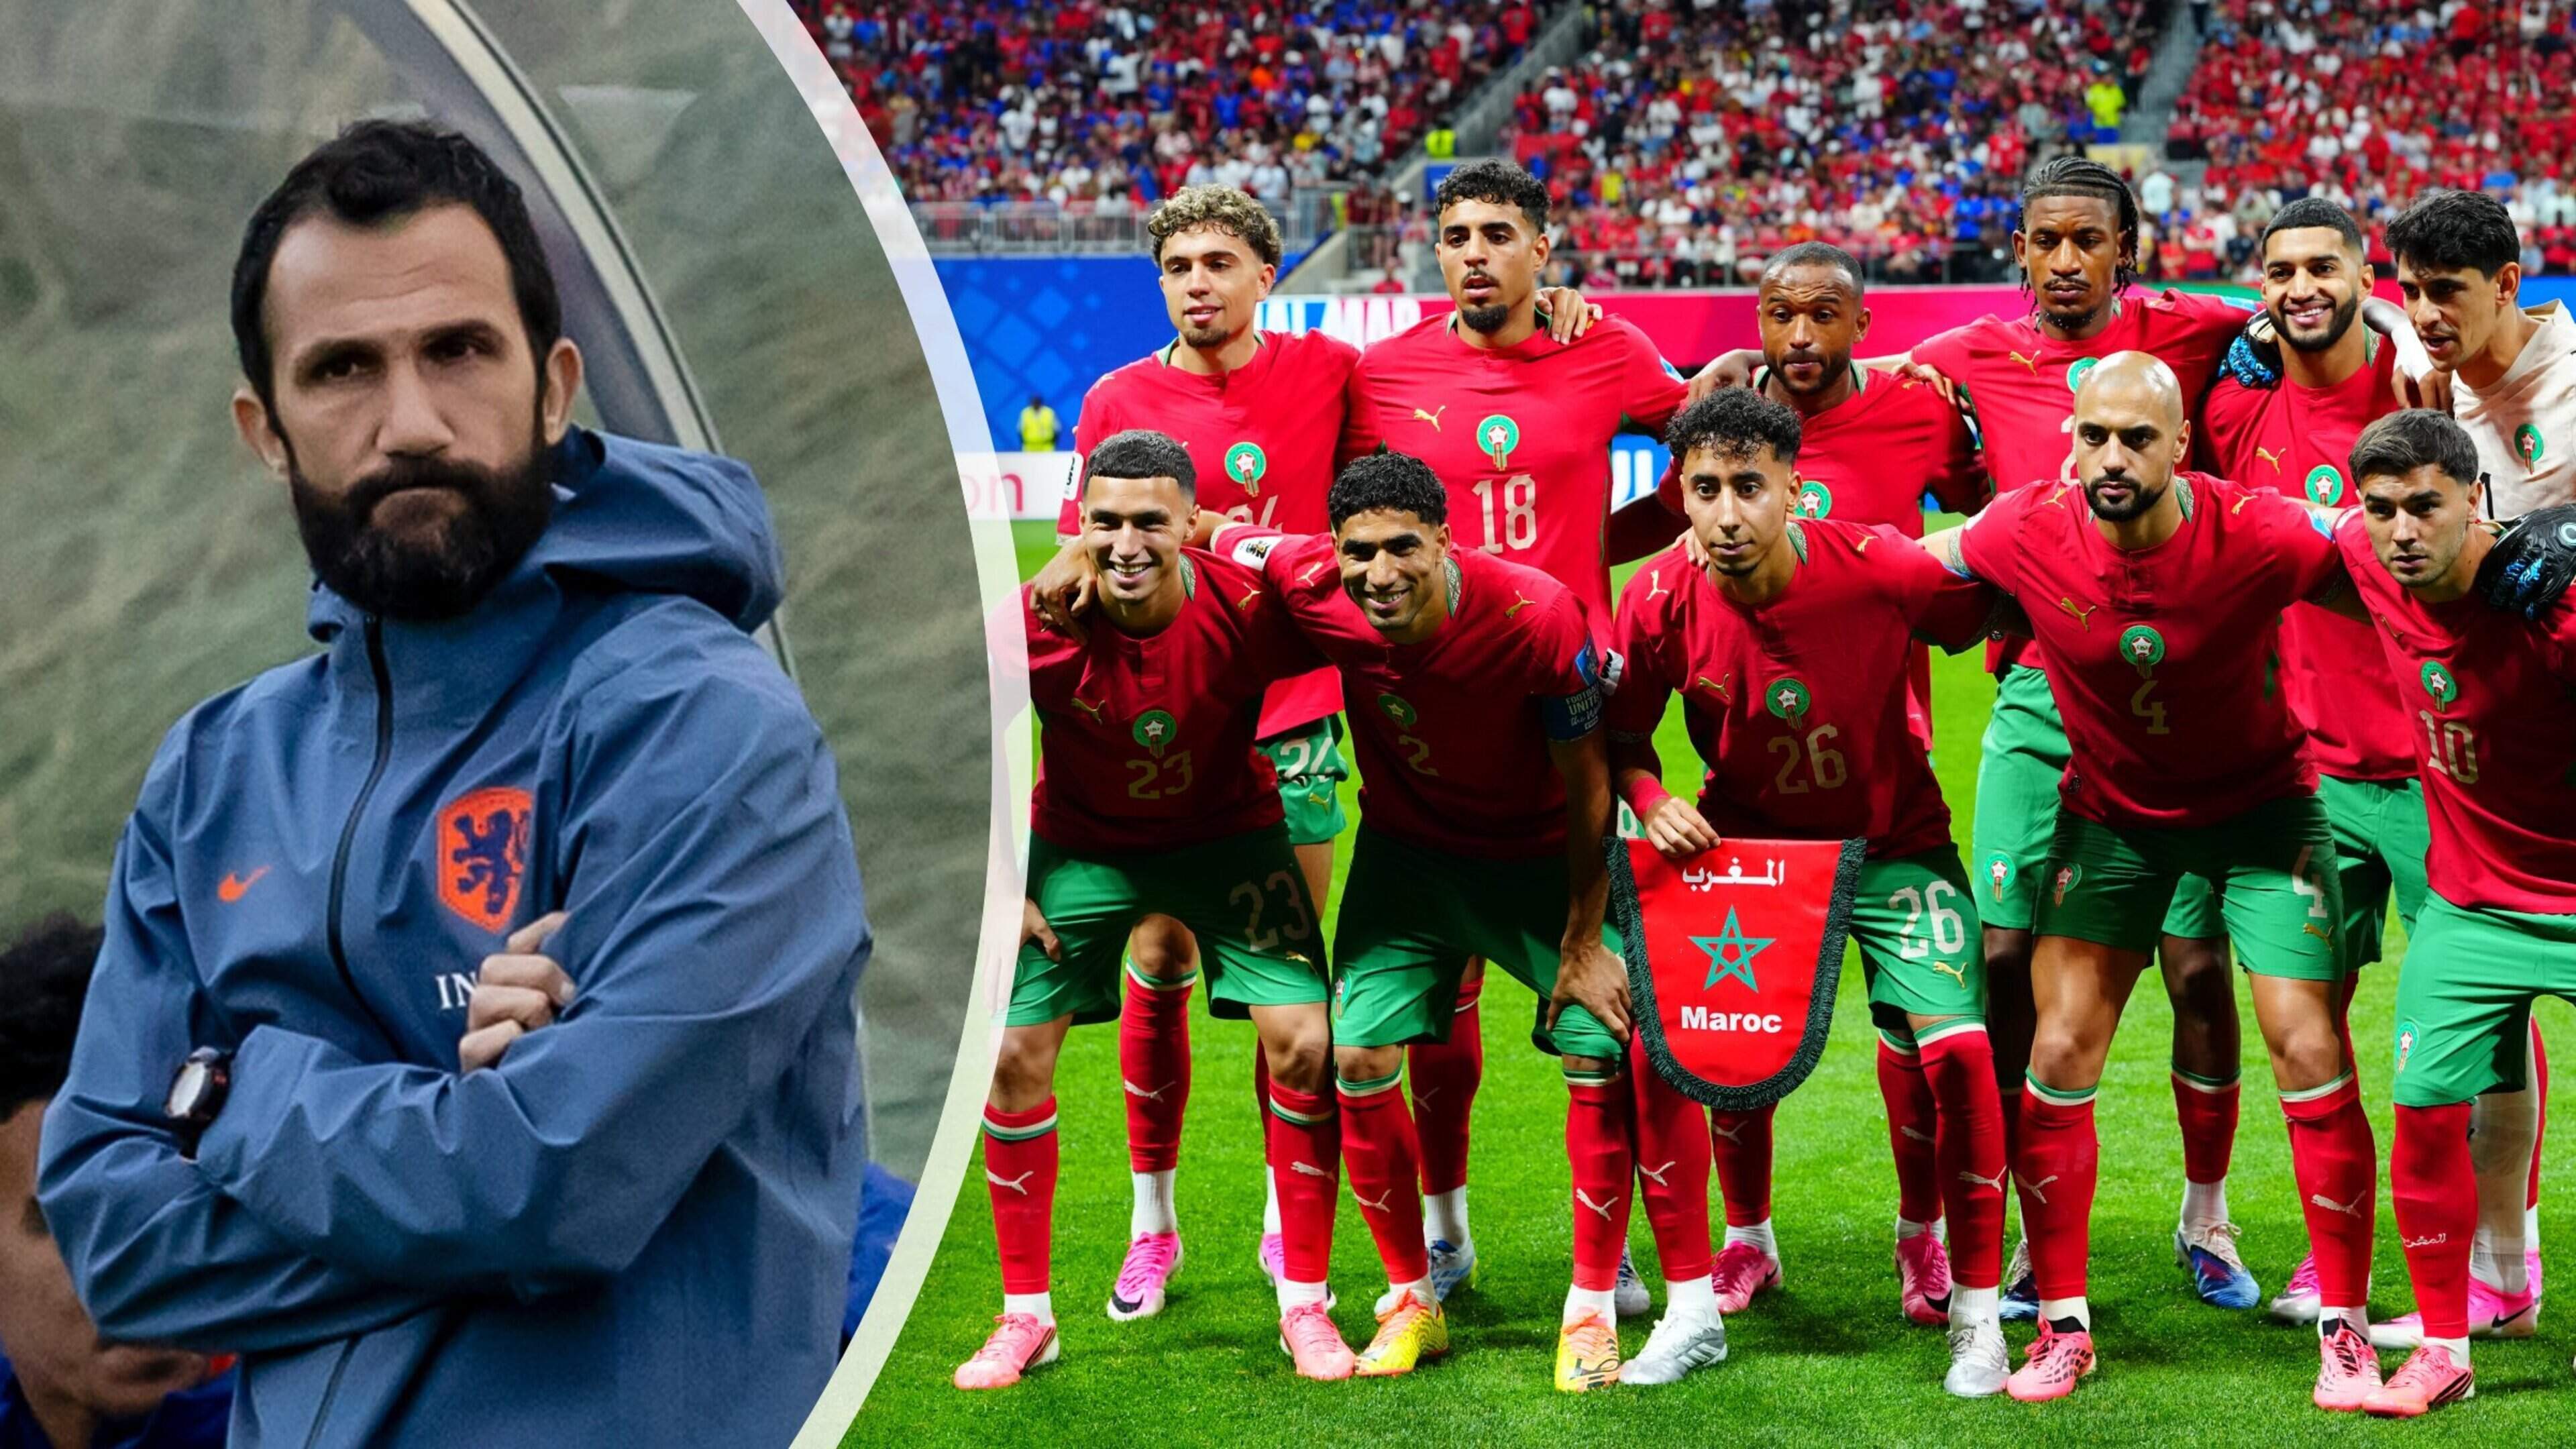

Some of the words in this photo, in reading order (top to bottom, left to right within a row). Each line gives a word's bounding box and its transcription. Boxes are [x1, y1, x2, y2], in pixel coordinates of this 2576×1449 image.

[1472, 474, 1538, 554] 18
[2131, 680, 2169, 735] 4
[1126, 749, 1193, 799] 23
[1398, 735, 1440, 777] 2
[1767, 722, 1847, 795] 26
[2419, 709, 2479, 785] 10
[1682, 857, 1784, 892] المغرب
[2292, 845, 2328, 918] 4
[1229, 871, 1311, 952] 23
[1888, 880, 1965, 959] 26
[1681, 1006, 1782, 1033] Maroc
